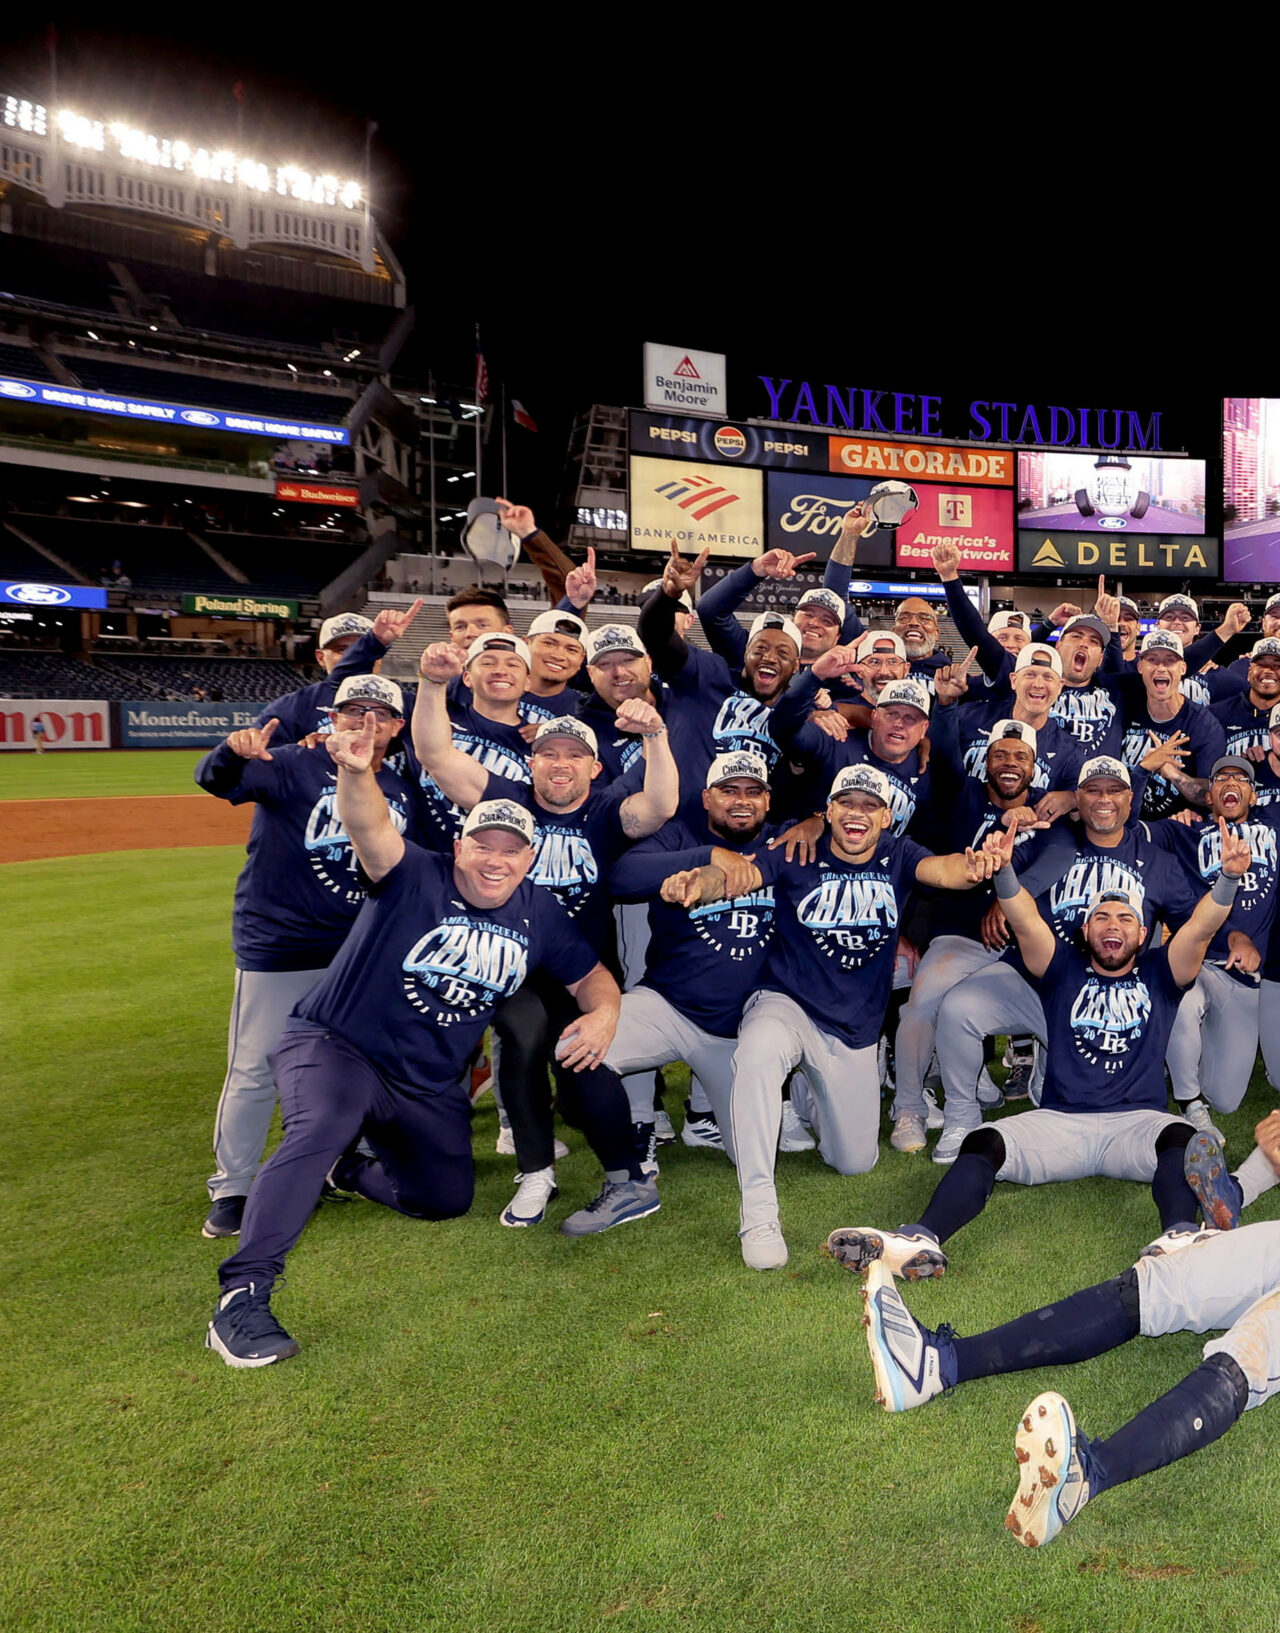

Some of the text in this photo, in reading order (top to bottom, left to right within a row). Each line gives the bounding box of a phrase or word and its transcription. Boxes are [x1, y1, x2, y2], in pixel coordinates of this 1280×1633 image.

[656, 376, 718, 396] Benjamin
[664, 390, 708, 406] Moore
[758, 376, 1163, 451] YANKEE STADIUM
[649, 426, 697, 444] PEPSI
[716, 436, 744, 447] PEPSI
[764, 440, 808, 456] PEPSI
[840, 444, 1007, 479] GATORADE
[301, 488, 357, 503] Budweiser
[634, 527, 759, 546] BANK OF AMERICA
[913, 532, 997, 548] America's
[958, 547, 1010, 562] etwork
[1077, 541, 1207, 568] DELTA
[195, 596, 290, 618] Poland Spring
[593, 635, 634, 651] CHAMPIONS
[1146, 640, 1179, 650] CHAMPIONS
[347, 687, 394, 703] CHAMPIONS
[889, 689, 925, 707] CHAMPIONS
[127, 710, 229, 726] Montefiore
[452, 732, 484, 745] ERICAN
[1066, 718, 1094, 743] TB
[729, 740, 742, 751] 20
[722, 764, 763, 780] CHAMPIONS
[1086, 768, 1122, 778] CHAMPIONS
[841, 777, 883, 794] CHAMPIONS
[1155, 786, 1165, 796] 26
[479, 812, 527, 830] CHAMPIONS
[327, 846, 341, 861] 20
[1259, 867, 1269, 879] 26
[568, 886, 582, 897] 26
[797, 880, 898, 929] CHAMPS
[1063, 909, 1076, 922] 20
[726, 910, 758, 939] TB
[762, 910, 775, 922] 26
[827, 928, 881, 951] TB 26
[402, 924, 528, 998] CHAMPS
[424, 974, 496, 1008] 20 TB 26
[1084, 1029, 1130, 1055] 20 TB
